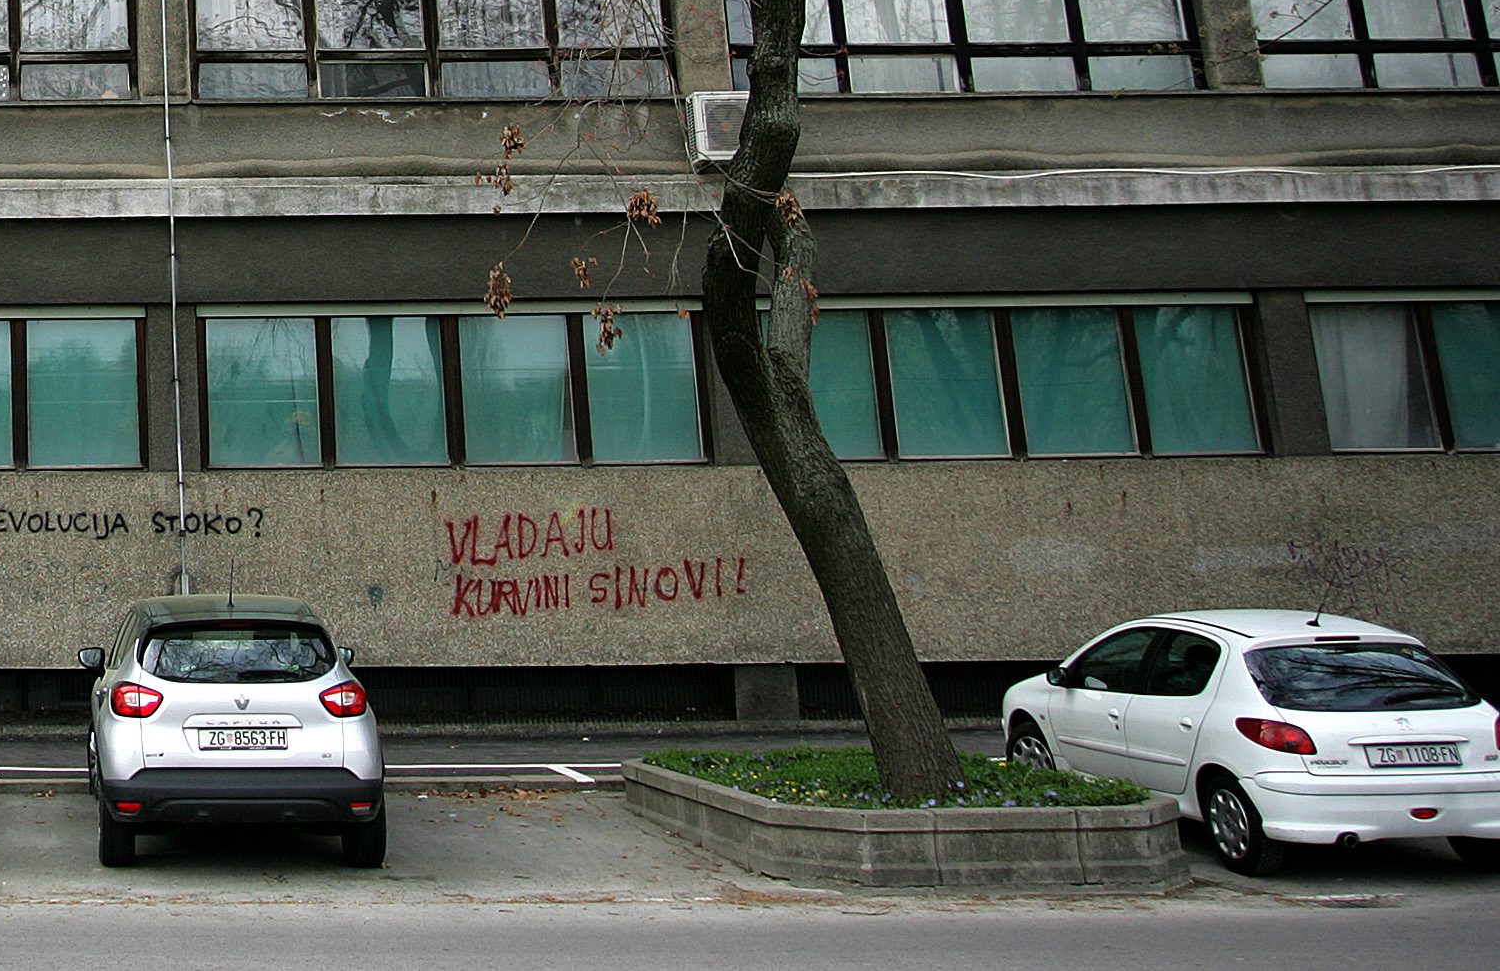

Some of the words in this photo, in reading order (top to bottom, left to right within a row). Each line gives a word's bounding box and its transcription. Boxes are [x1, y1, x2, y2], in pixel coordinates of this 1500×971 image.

[445, 508, 613, 565] VLADAJU
[451, 574, 570, 617] KURVINI
[589, 557, 746, 609] SINOVI!
[209, 731, 225, 746] ZG
[1377, 748, 1397, 763] ZG
